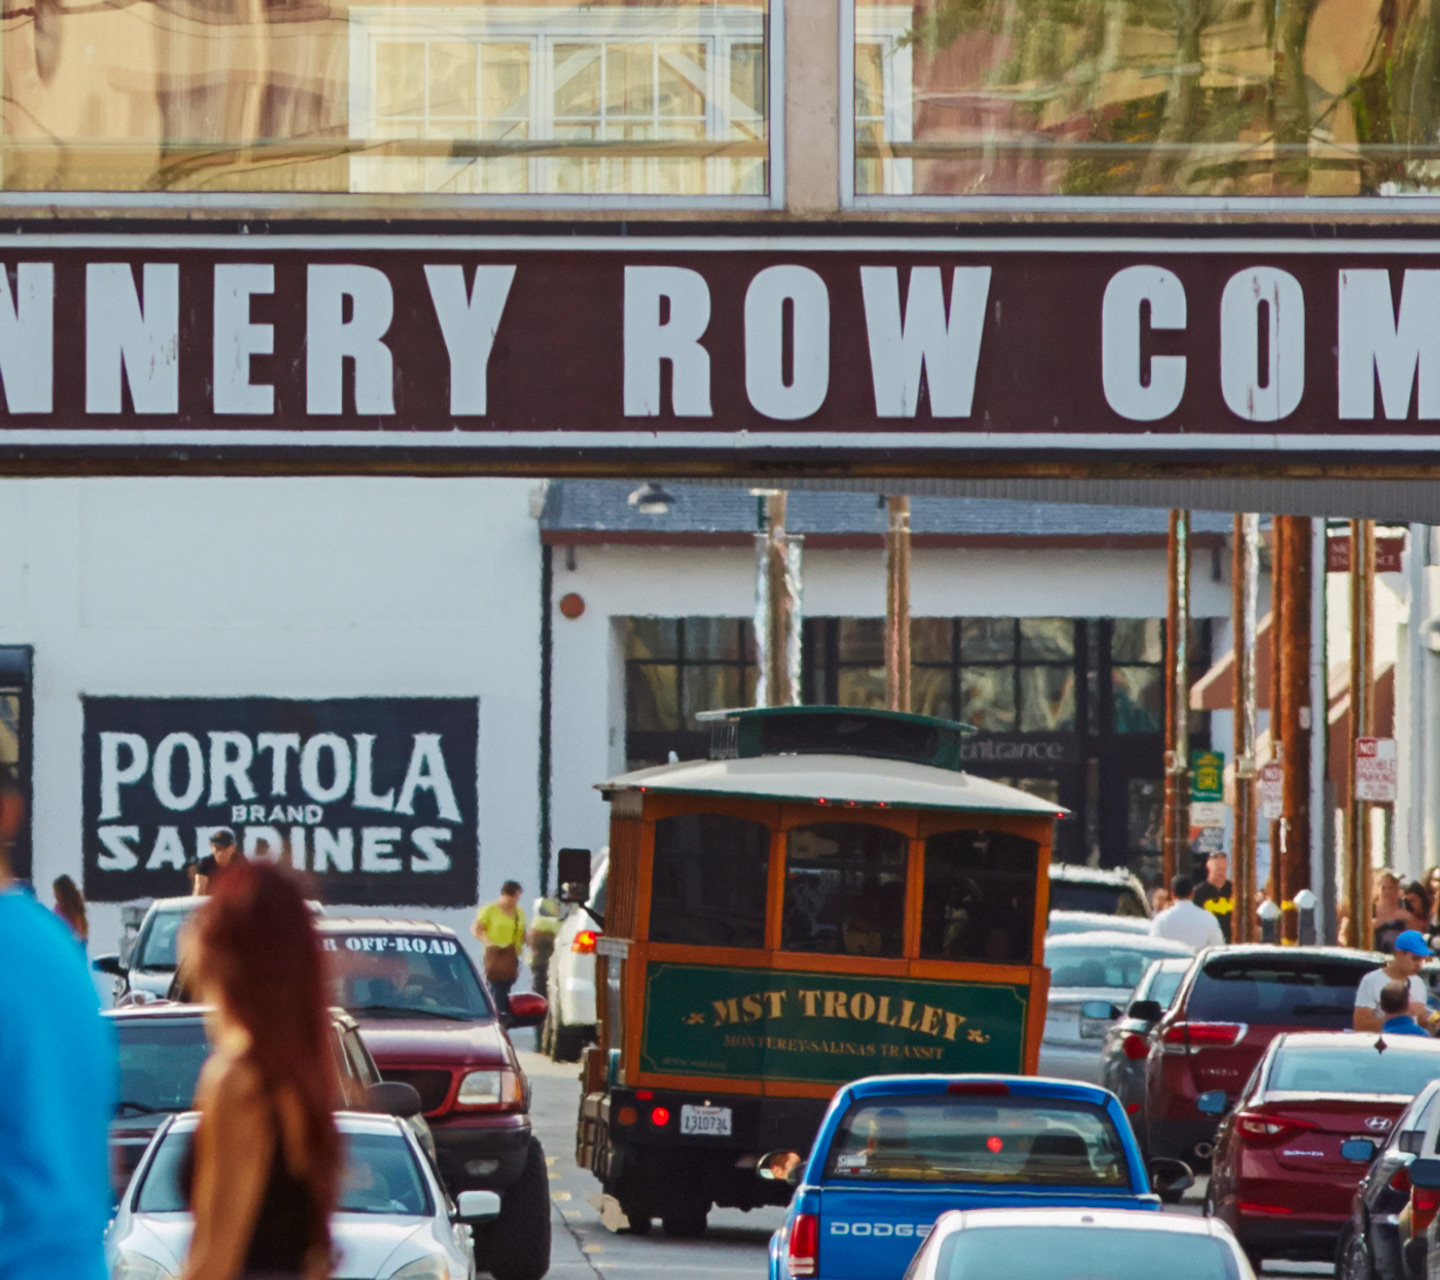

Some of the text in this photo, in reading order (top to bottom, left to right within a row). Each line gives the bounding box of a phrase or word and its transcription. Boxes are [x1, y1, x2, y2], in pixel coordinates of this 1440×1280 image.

[625, 260, 990, 420] ROW
[1359, 742, 1376, 756] NO
[97, 731, 463, 824] PORTOLA
[231, 803, 324, 825] BRAND
[345, 936, 458, 956] OFF-ROAD
[712, 989, 968, 1042] MST TROLLEY
[723, 1034, 945, 1062] MONTEREY-SALINAS TRANSIT
[830, 1221, 935, 1238] DODGE
